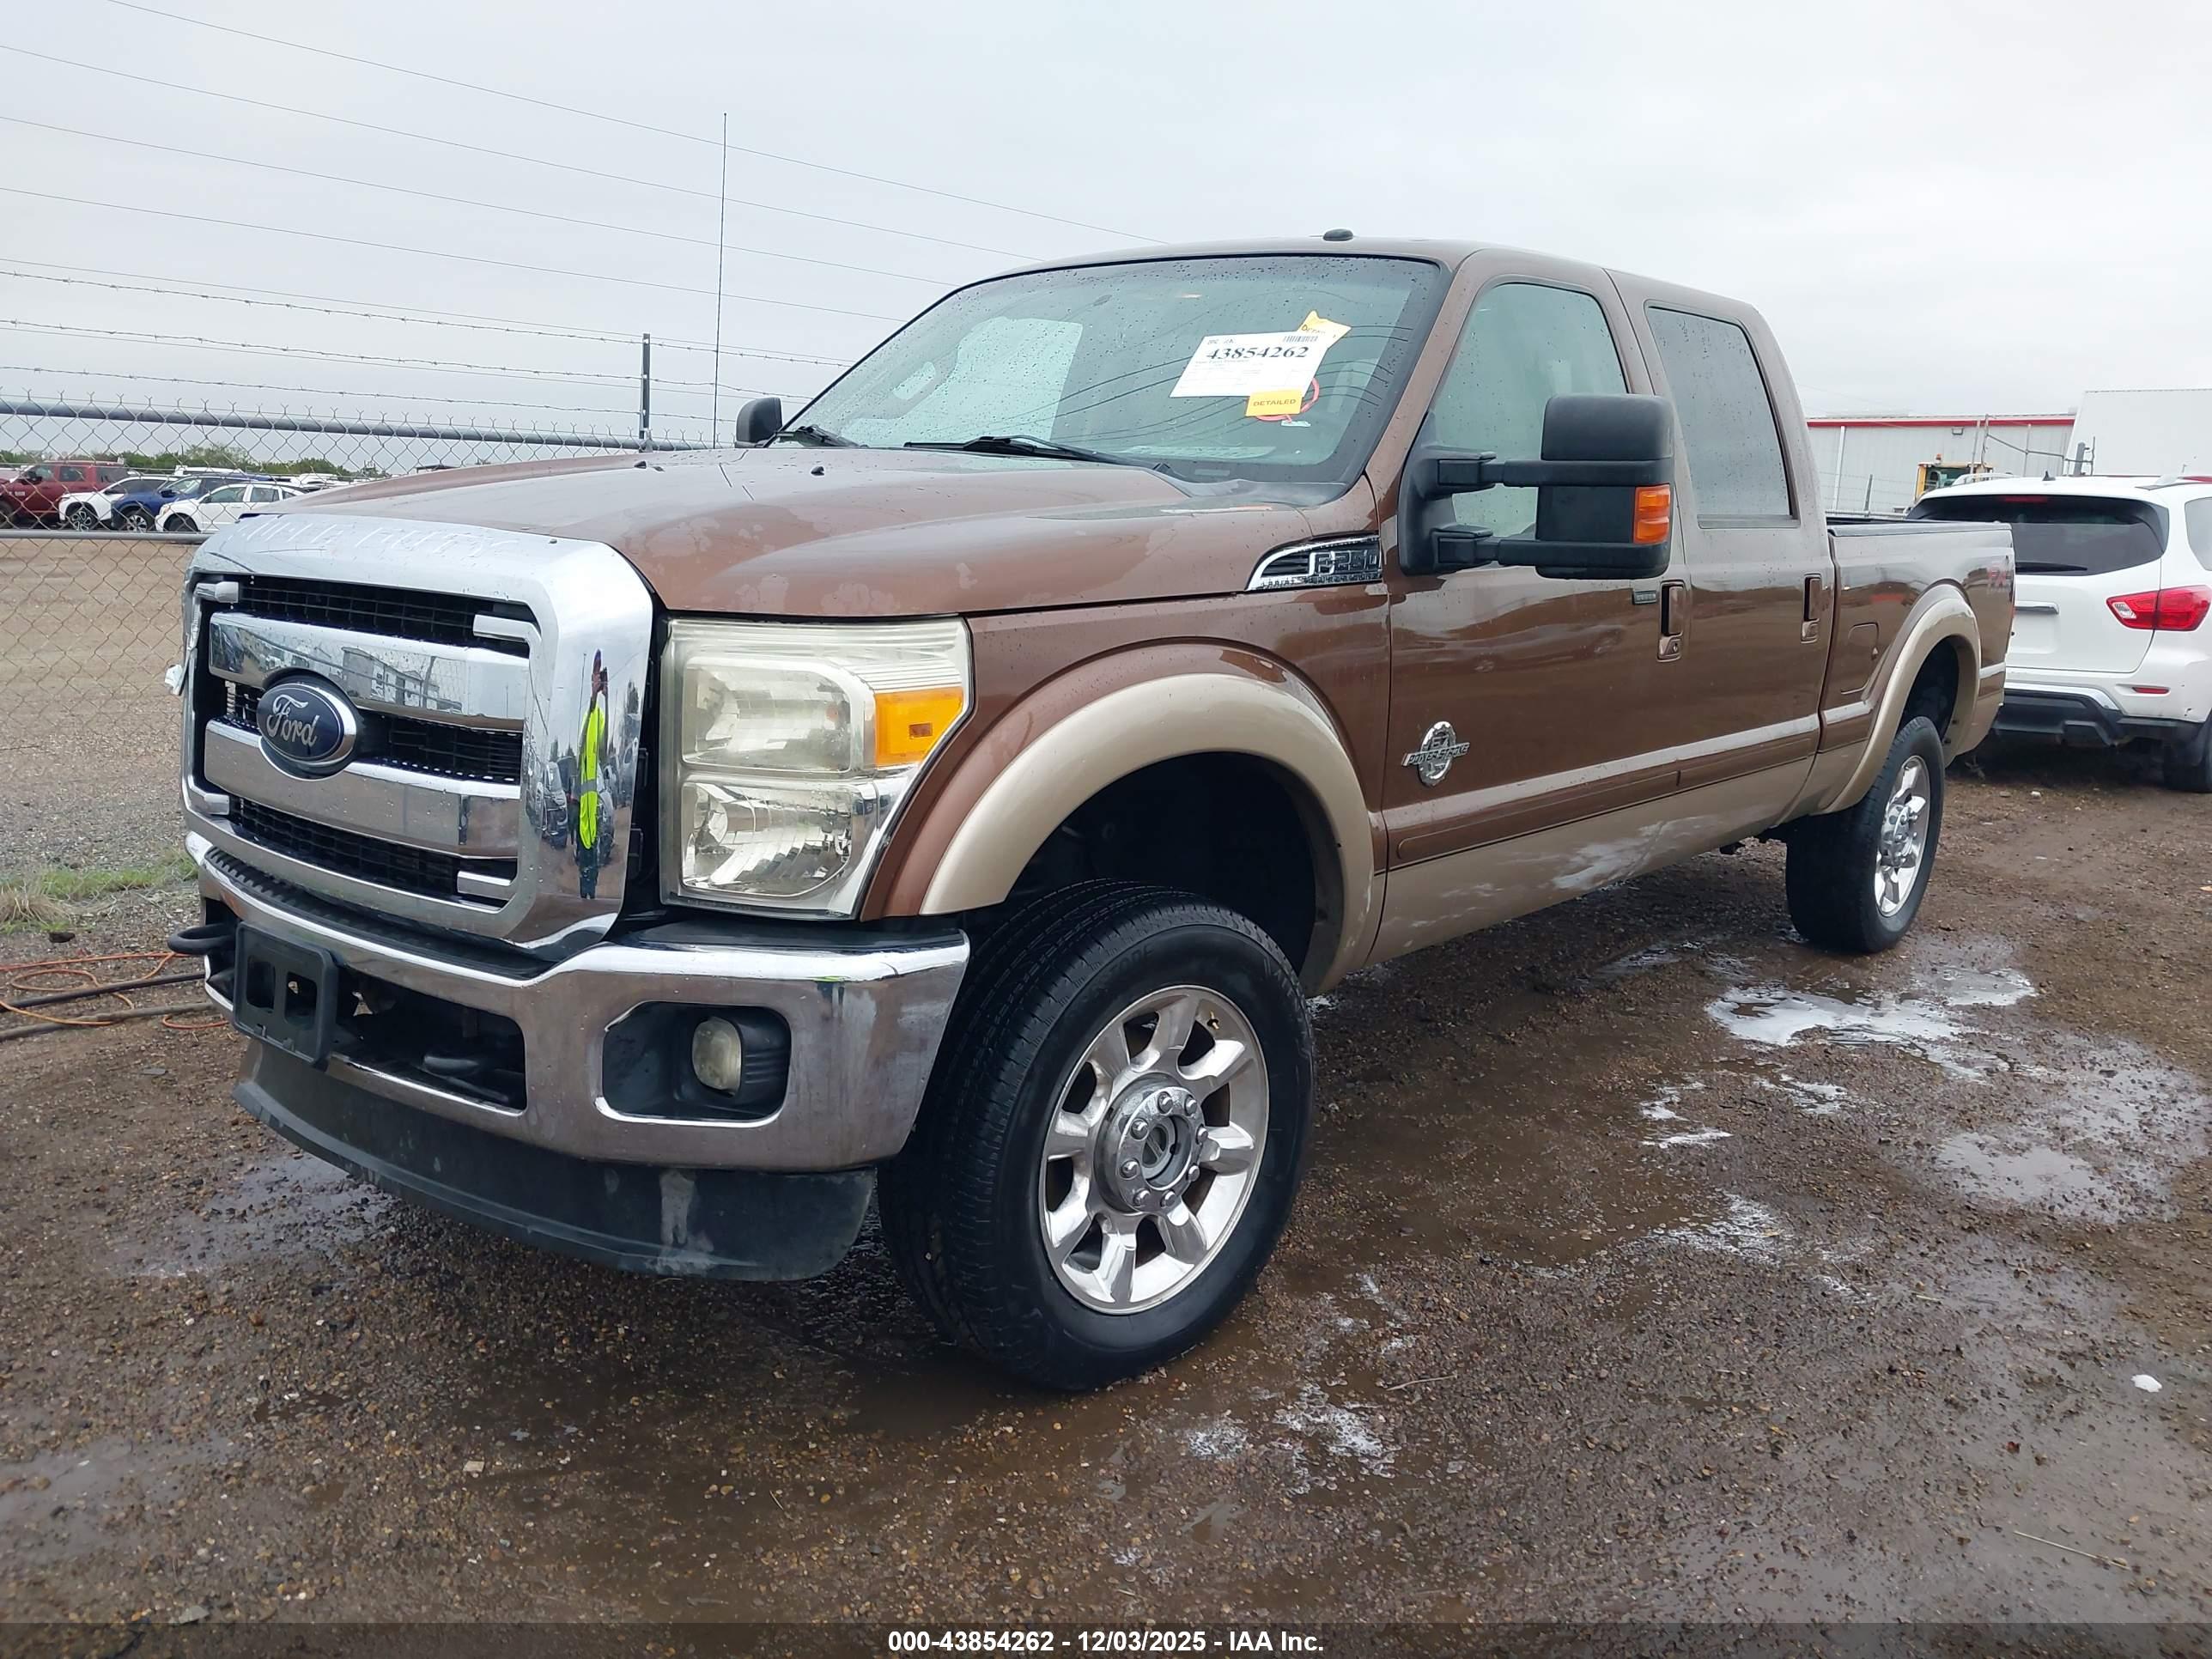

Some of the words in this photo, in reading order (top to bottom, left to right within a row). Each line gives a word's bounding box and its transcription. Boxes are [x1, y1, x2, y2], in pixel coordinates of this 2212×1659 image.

[1206, 345, 1310, 360] 43854262
[1253, 398, 1297, 407] DETAILED
[266, 694, 320, 747] Ford
